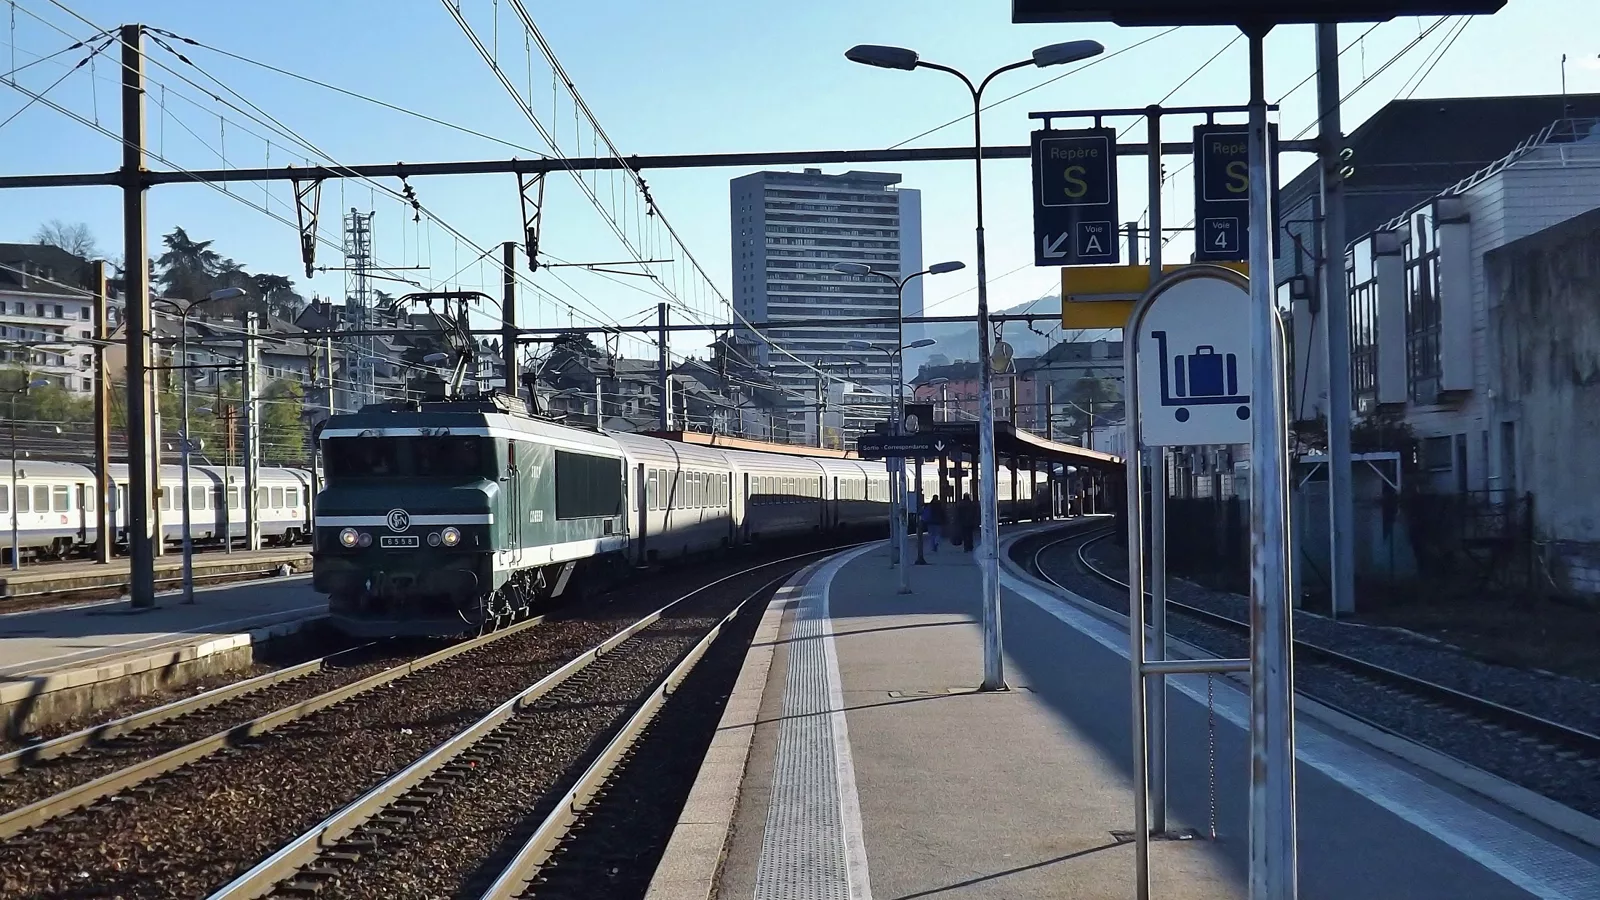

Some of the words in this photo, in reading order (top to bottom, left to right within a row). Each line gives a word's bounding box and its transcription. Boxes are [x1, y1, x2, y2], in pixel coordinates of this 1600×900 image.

[1051, 147, 1098, 160] Repère
[1213, 141, 1247, 155] Repè
[1063, 165, 1088, 198] S
[1225, 161, 1249, 193] S
[1085, 225, 1103, 233] Voie
[1212, 221, 1230, 229] Voie
[1086, 235, 1102, 253] A
[1214, 231, 1227, 249] 4
